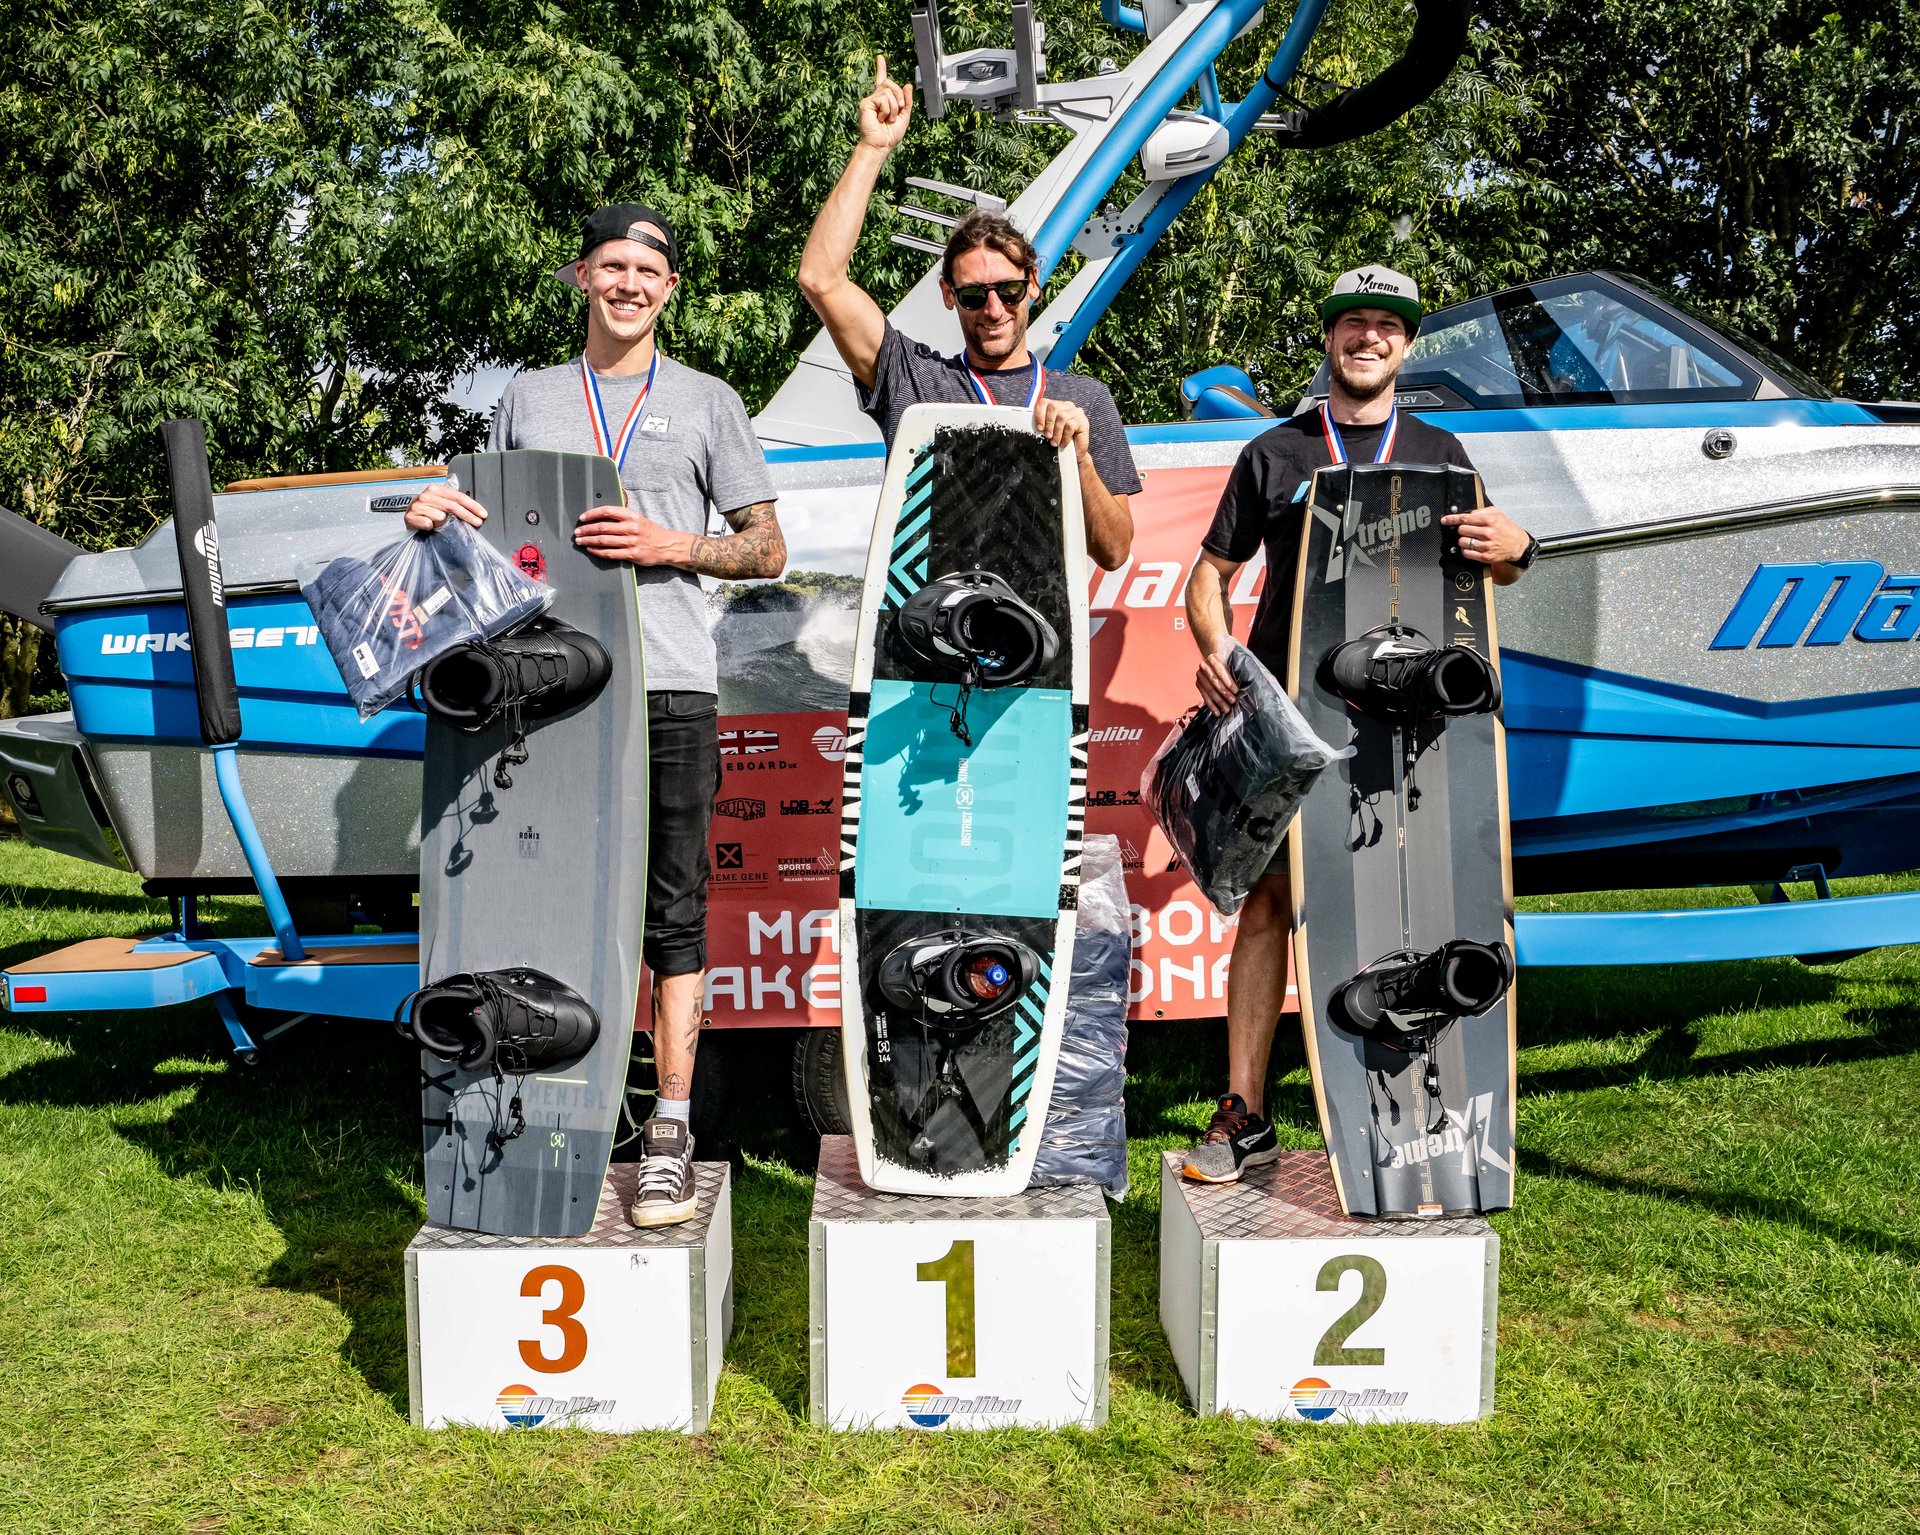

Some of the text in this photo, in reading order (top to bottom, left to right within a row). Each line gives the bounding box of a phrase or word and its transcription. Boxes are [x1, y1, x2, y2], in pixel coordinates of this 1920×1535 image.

[1355, 273, 1400, 294] Xtreme
[377, 496, 413, 508] Malib
[1309, 501, 1431, 584] Xtreme
[205, 535, 224, 607] Malibu
[1708, 560, 1920, 651] Ma
[1088, 727, 1143, 743] alibu
[726, 761, 787, 771] EBOARD
[718, 800, 763, 815] QUAYS
[519, 832, 540, 840] RONIX
[960, 811, 972, 846] DISTRICT
[778, 863, 811, 871] SPORTS
[778, 868, 841, 877] PERFORMANCE
[709, 872, 769, 882] REME GENE
[748, 909, 840, 955] MA
[703, 964, 840, 1011] AKE
[878, 1054, 891, 1063] 144
[917, 1240, 976, 1378] 1
[1313, 1254, 1388, 1367] 2
[518, 1264, 588, 1374] 3
[519, 1396, 617, 1415] Malibu
[925, 1395, 1022, 1414] Malibu
[1312, 1388, 1408, 1407] Malibu
